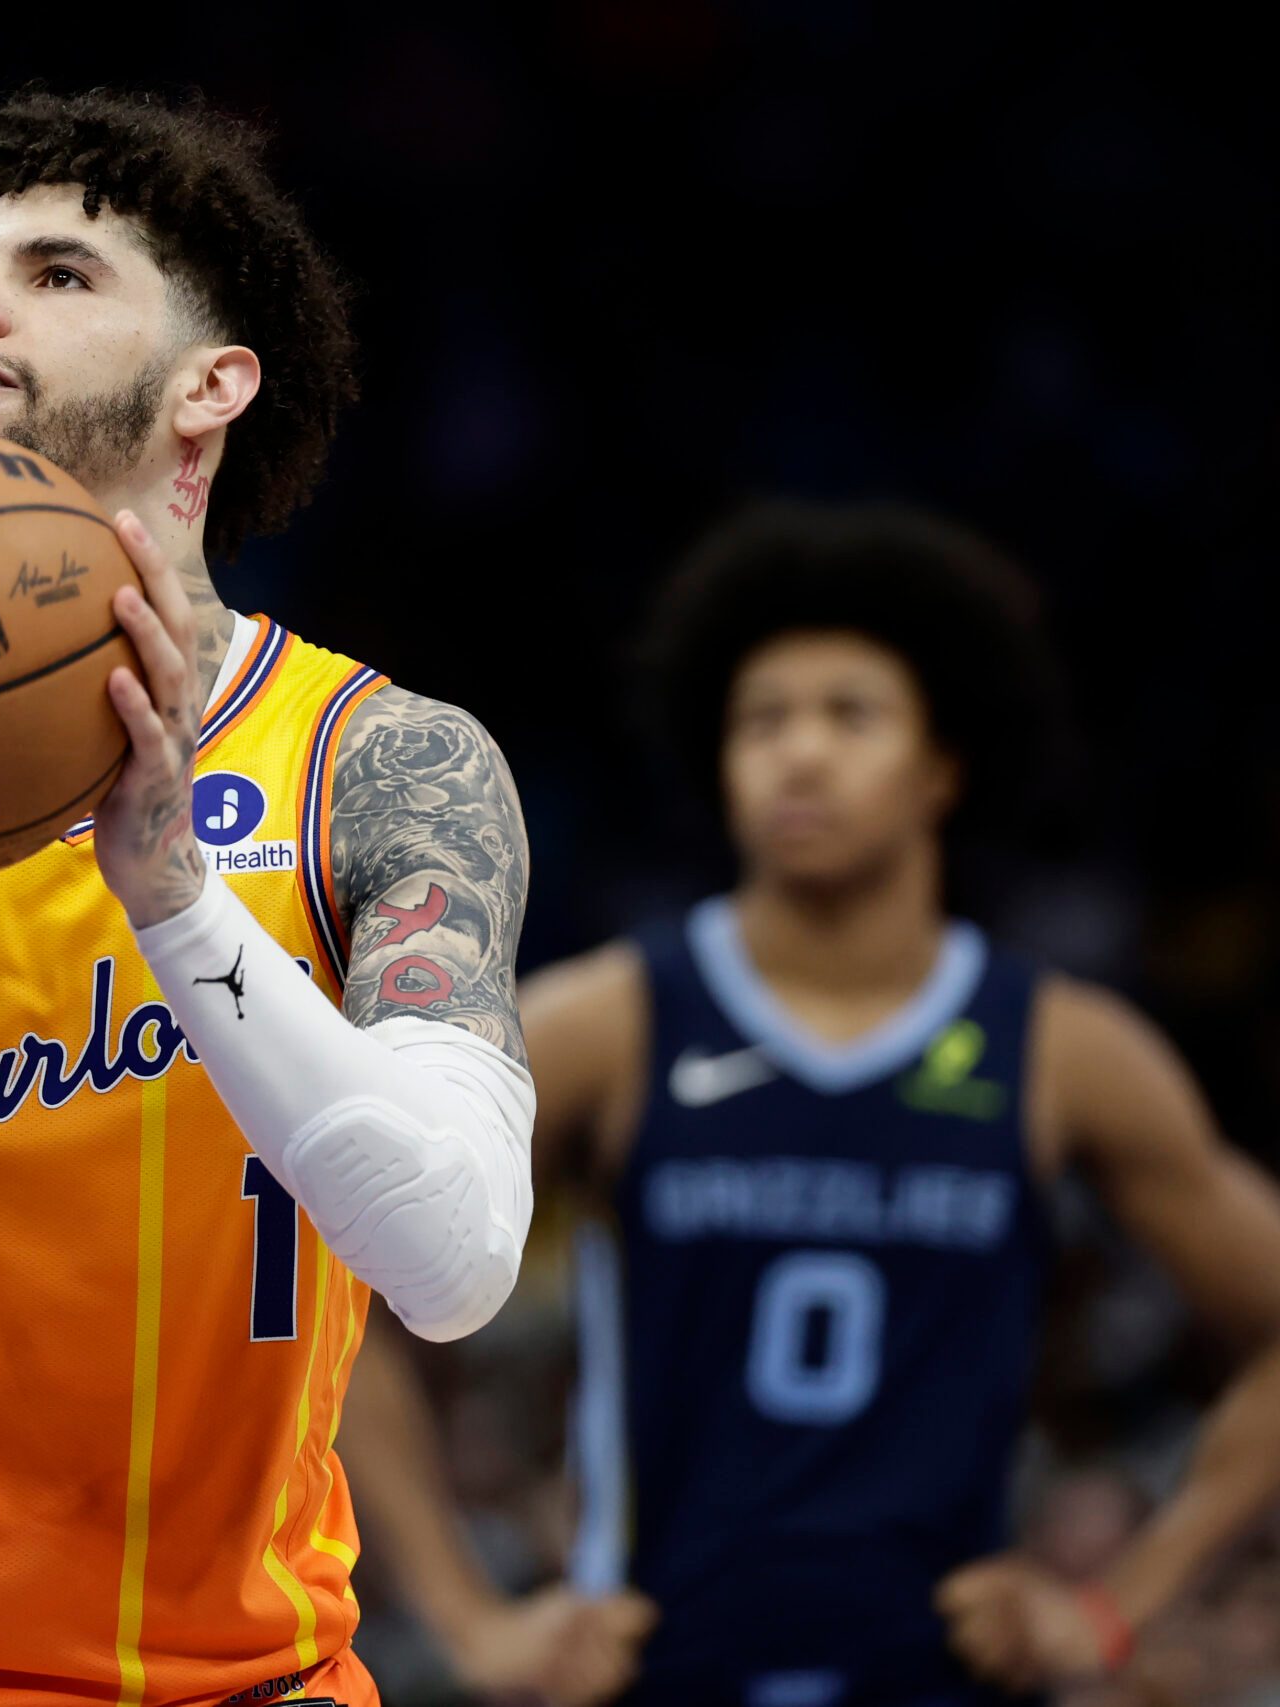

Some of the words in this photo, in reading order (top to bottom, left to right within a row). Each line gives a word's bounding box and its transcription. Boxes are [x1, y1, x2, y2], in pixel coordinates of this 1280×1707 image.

[216, 843, 293, 871] Health
[241, 1153, 298, 1342] 1
[746, 1247, 889, 1426] 0
